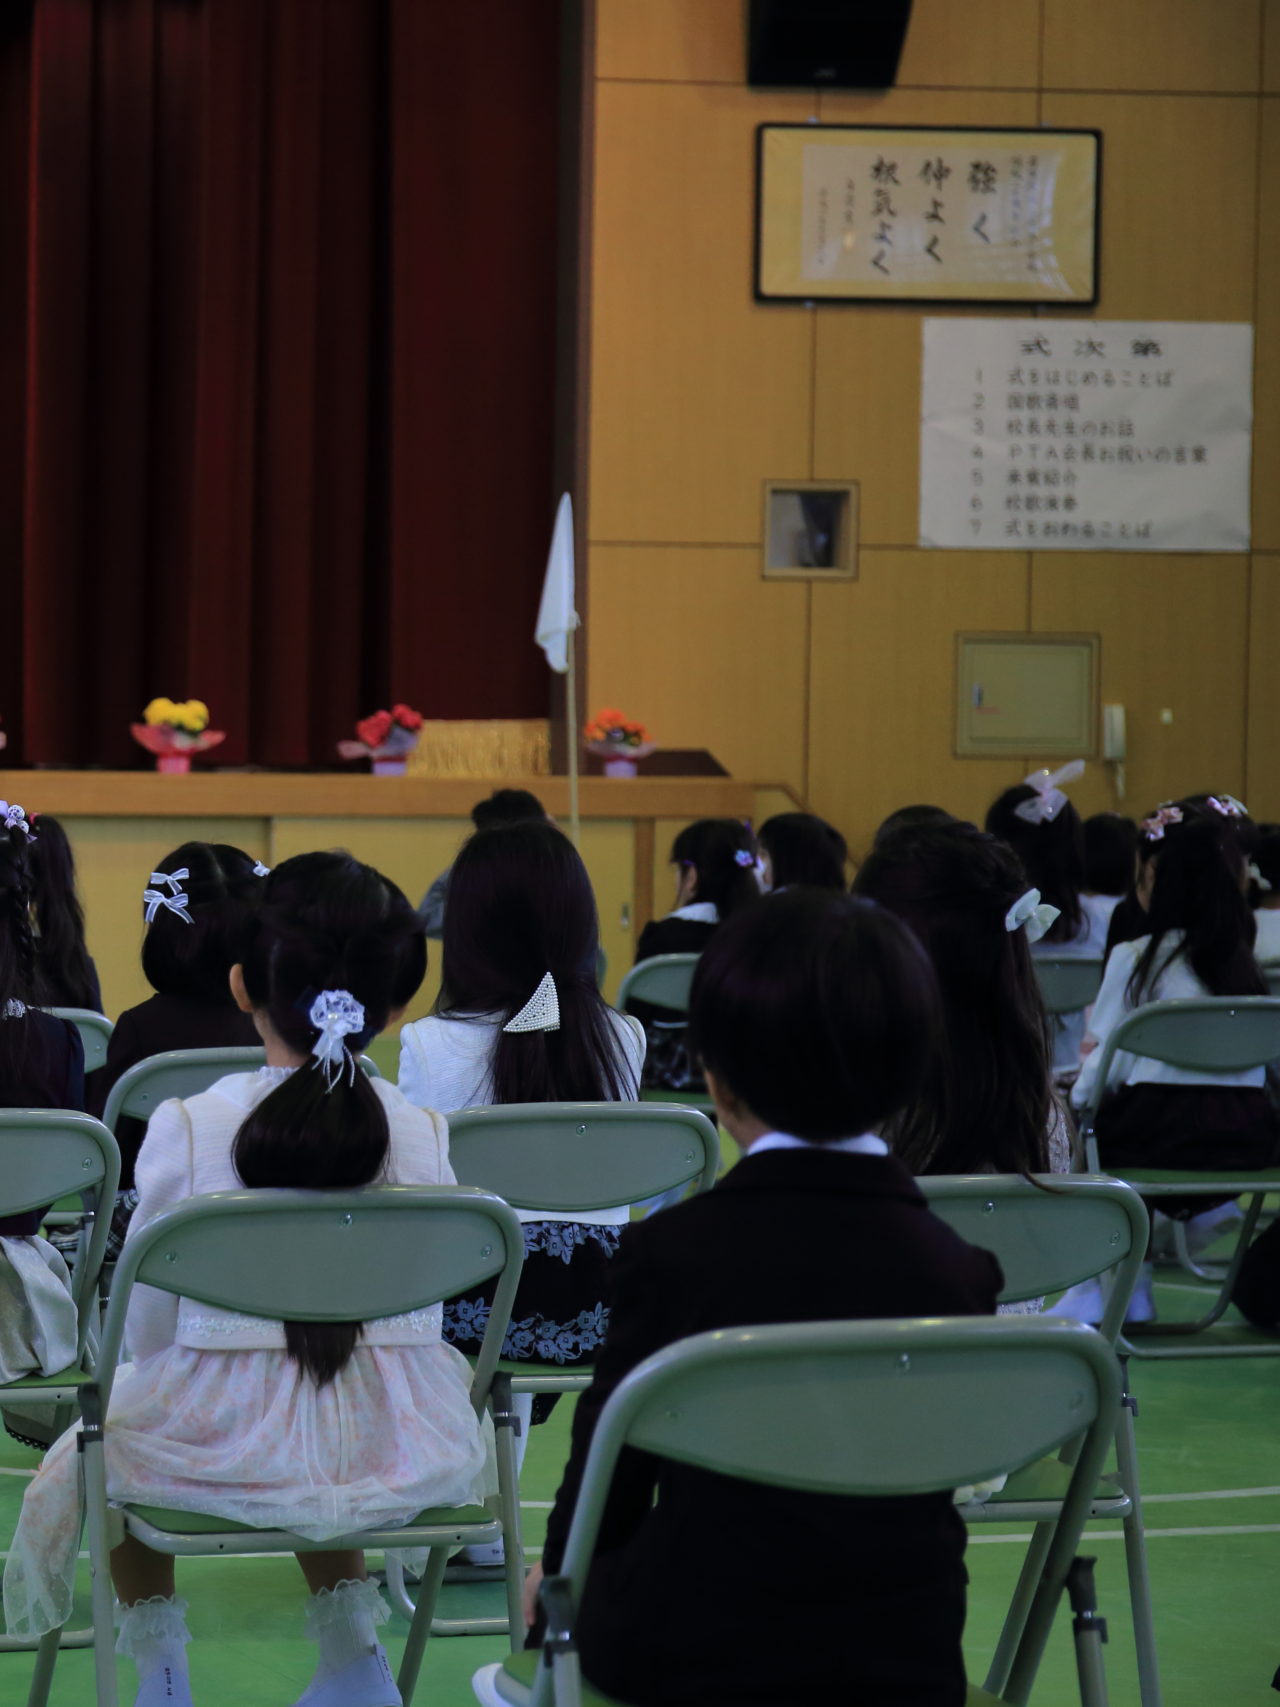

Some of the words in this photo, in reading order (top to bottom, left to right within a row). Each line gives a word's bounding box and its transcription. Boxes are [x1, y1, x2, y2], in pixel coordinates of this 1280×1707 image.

[872, 154, 901, 276] 根気よく
[919, 156, 952, 264] 仲よく
[974, 392, 984, 411] 2
[973, 417, 985, 436] 3
[973, 444, 984, 460] 4
[972, 470, 984, 487] 5
[970, 496, 982, 513] 6
